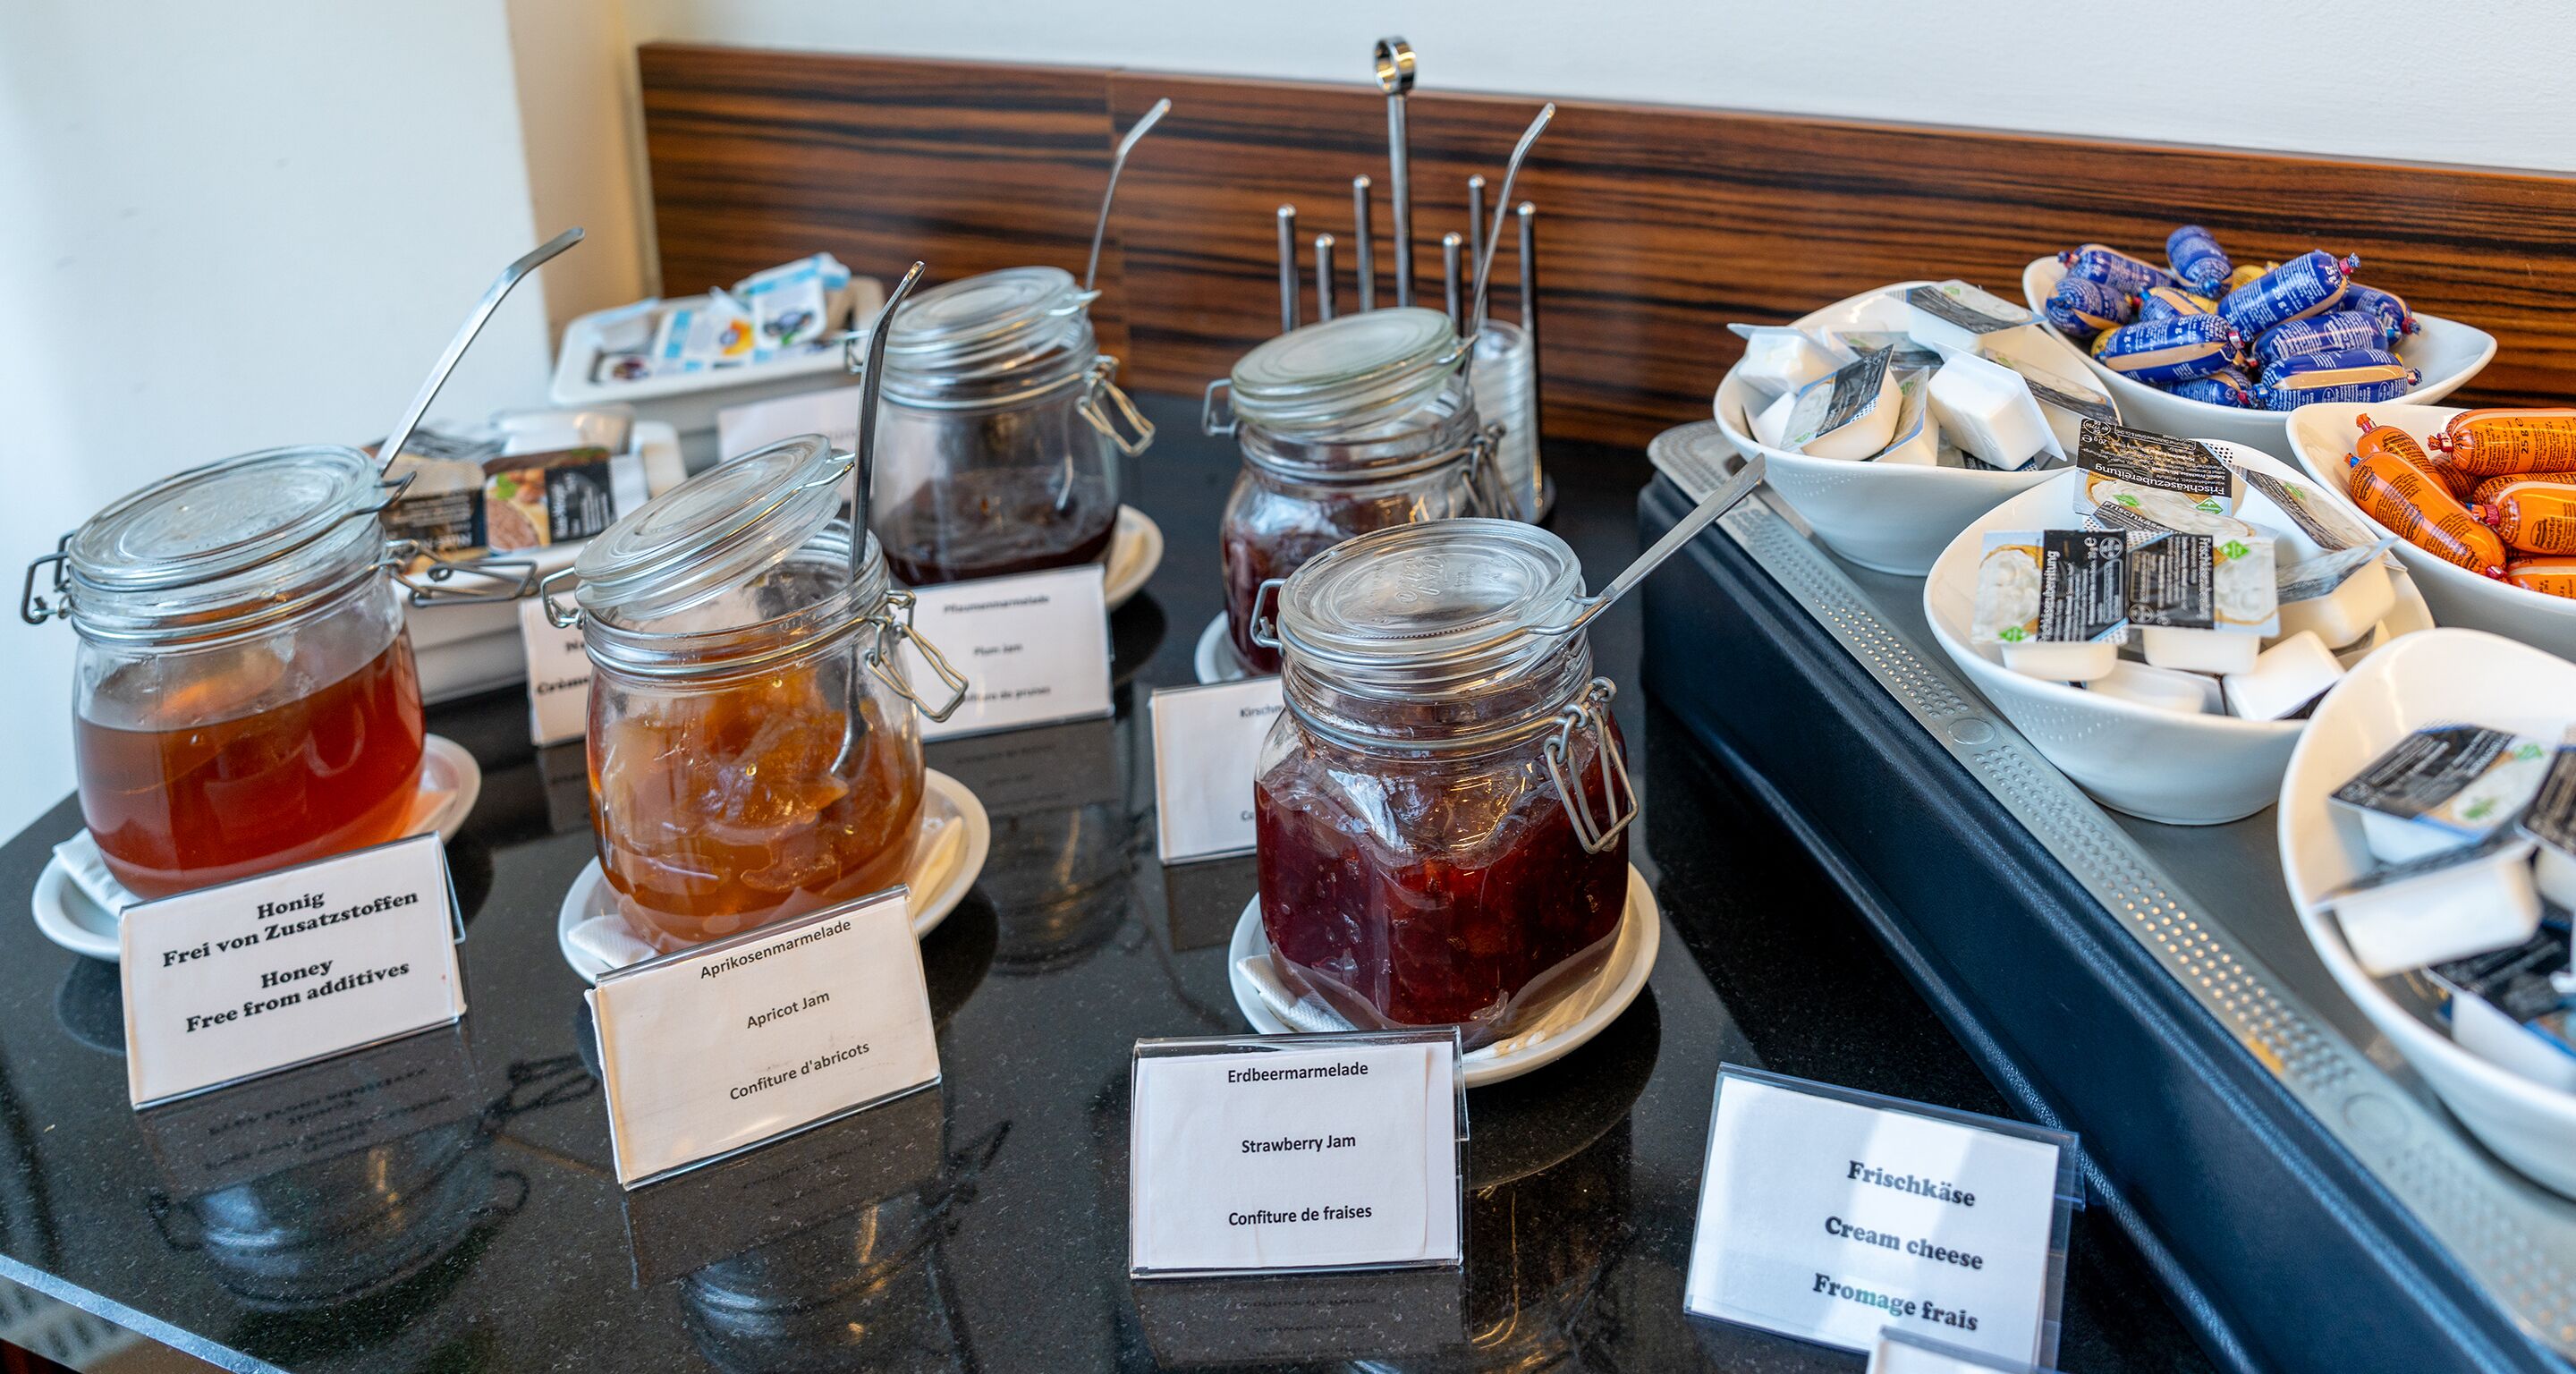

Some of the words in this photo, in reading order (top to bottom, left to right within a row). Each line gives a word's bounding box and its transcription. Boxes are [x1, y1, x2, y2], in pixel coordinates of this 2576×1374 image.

[2521, 440, 2529, 454] 25
[2095, 462, 2225, 496] Frischkäsezubereitung
[257, 891, 326, 920] Honig
[163, 943, 211, 967] Frei
[216, 932, 259, 952] von
[265, 891, 419, 941] Zusatzstoffen
[700, 920, 852, 980] Aprikosenmarmelade
[261, 959, 334, 988] Honey
[186, 1008, 238, 1032] Free
[243, 992, 301, 1017] from
[307, 962, 410, 1000] additives
[747, 1002, 799, 1030] Apricot
[802, 991, 830, 1010] Jam
[730, 1068, 797, 1101] Confiture
[801, 1042, 870, 1075] d'abricots
[1228, 1062, 1368, 1083] Erdbeermarmelade
[1241, 1136, 1323, 1154] Strawberry
[1326, 1134, 1356, 1149] Jam
[1847, 1160, 1976, 1208] Frischkäse
[1228, 1209, 1297, 1226] Confiture
[1301, 1208, 1319, 1222] de
[1324, 1205, 1372, 1220] fraises
[1825, 1216, 1901, 1251] Cream
[1906, 1237, 1984, 1270] cheese
[1813, 1273, 1916, 1317] Fromage
[1921, 1302, 1979, 1330] frais
